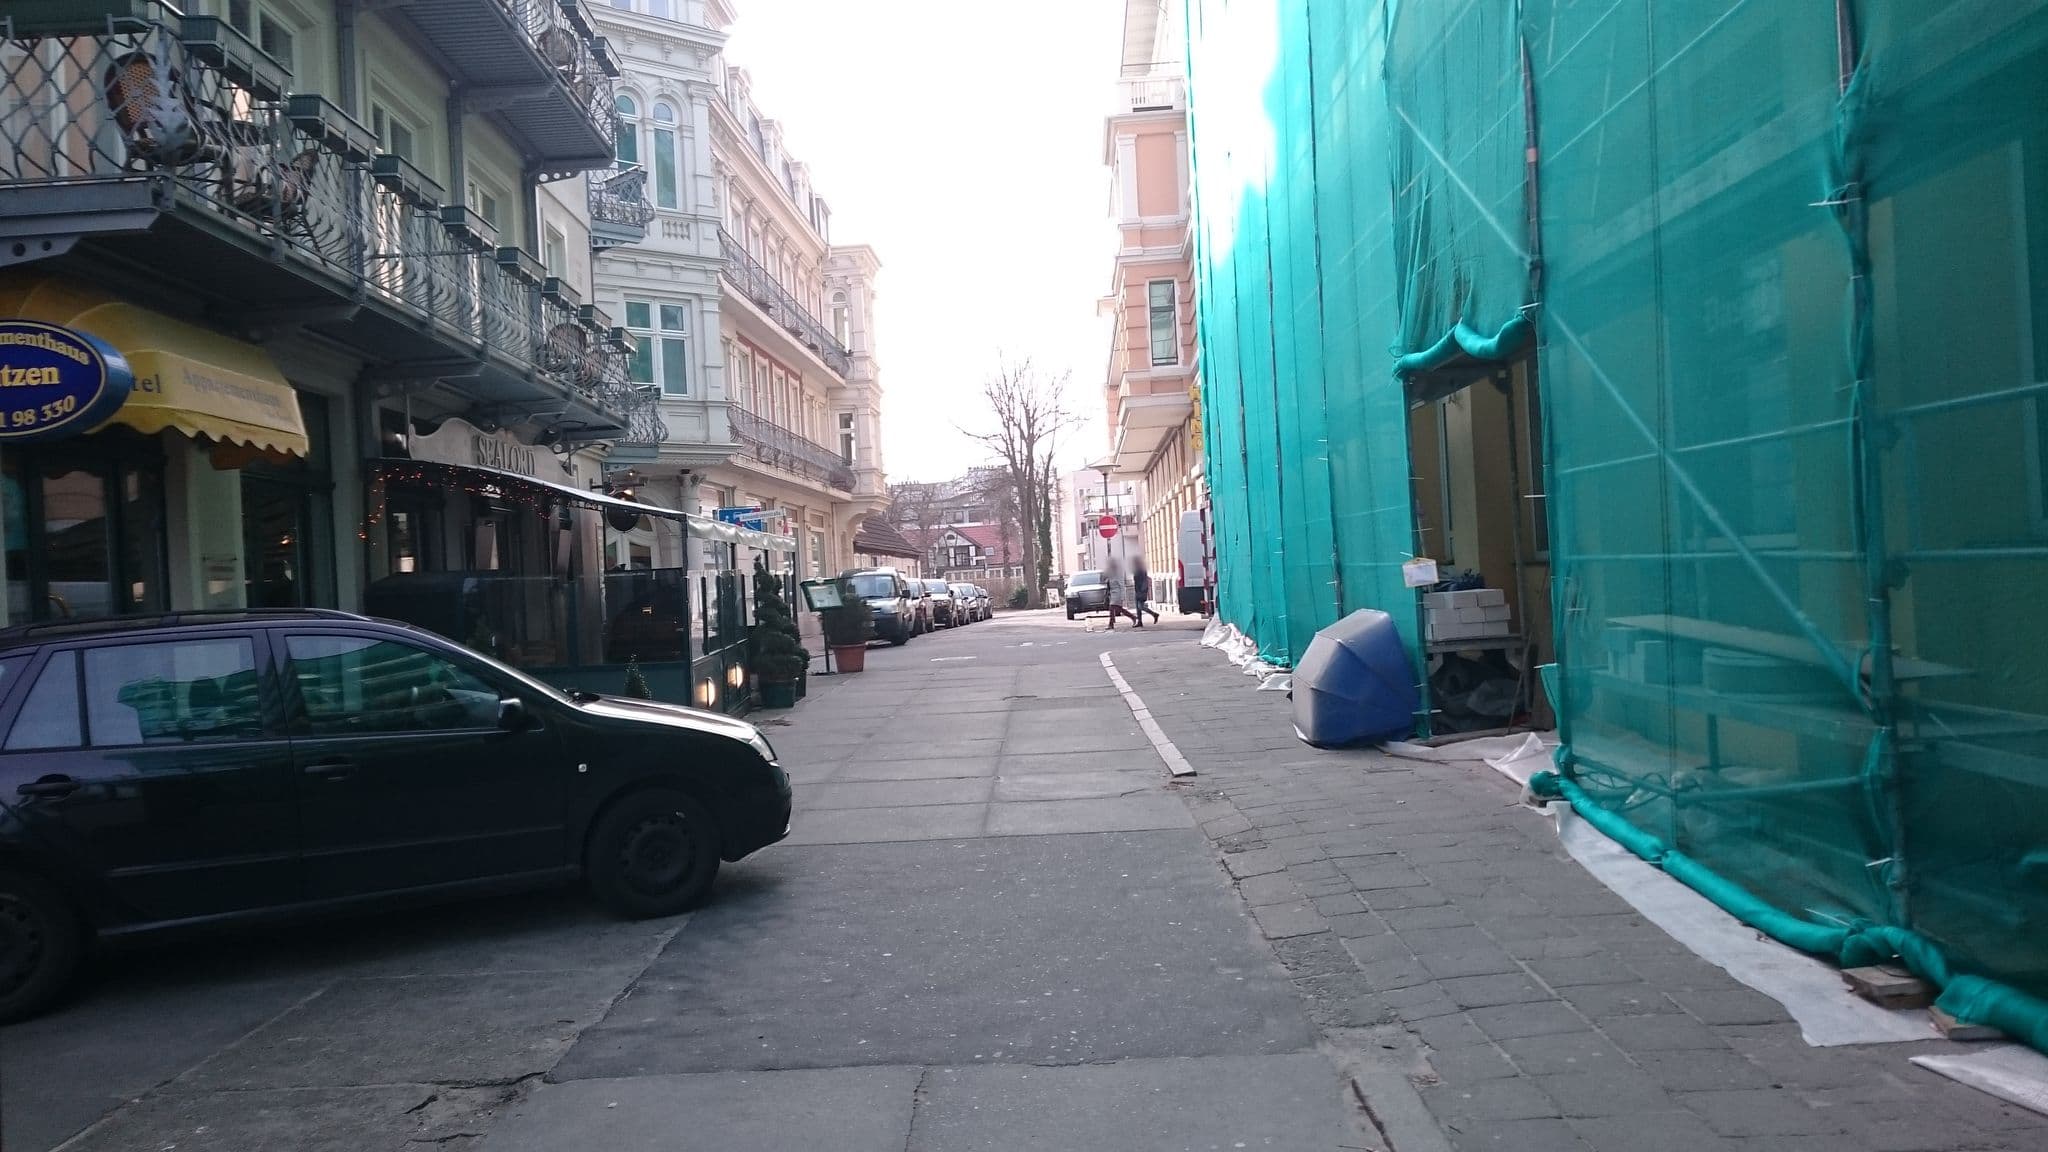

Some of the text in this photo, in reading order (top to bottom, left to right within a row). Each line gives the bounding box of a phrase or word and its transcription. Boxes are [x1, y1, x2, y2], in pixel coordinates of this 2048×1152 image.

[0, 364, 61, 388] tzen
[11, 408, 36, 427] 98
[40, 394, 76, 422] 330
[478, 436, 537, 477] SEALORD
